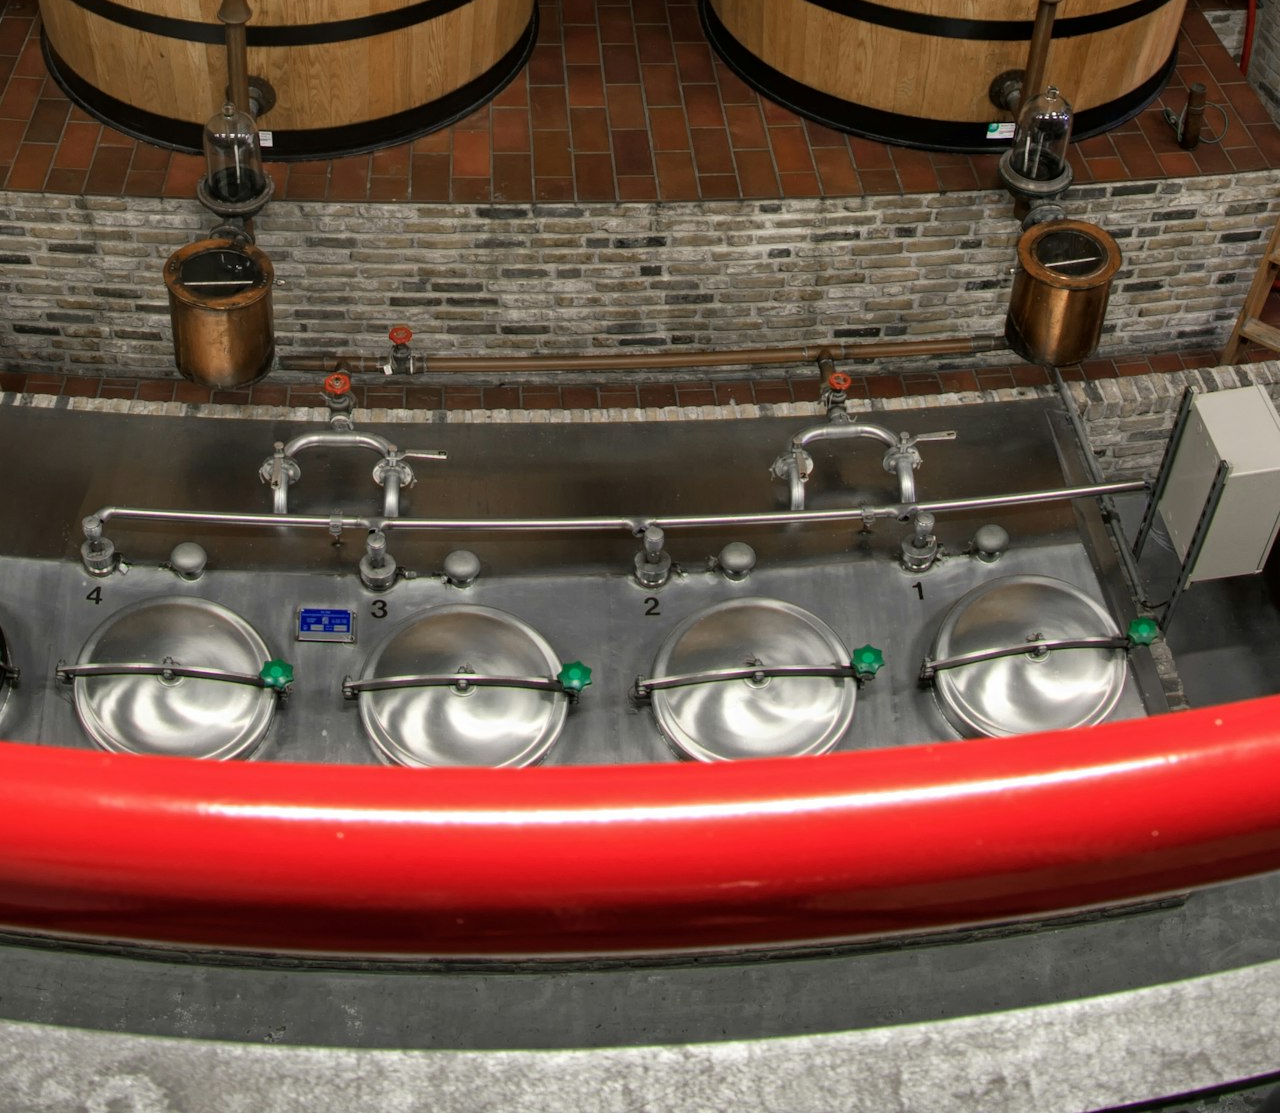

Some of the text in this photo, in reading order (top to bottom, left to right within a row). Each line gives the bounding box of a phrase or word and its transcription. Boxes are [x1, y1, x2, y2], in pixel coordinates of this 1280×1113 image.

[86, 586, 103, 605] 4
[912, 581, 924, 600] 1
[371, 599, 388, 619] 3
[644, 597, 661, 616] 2
